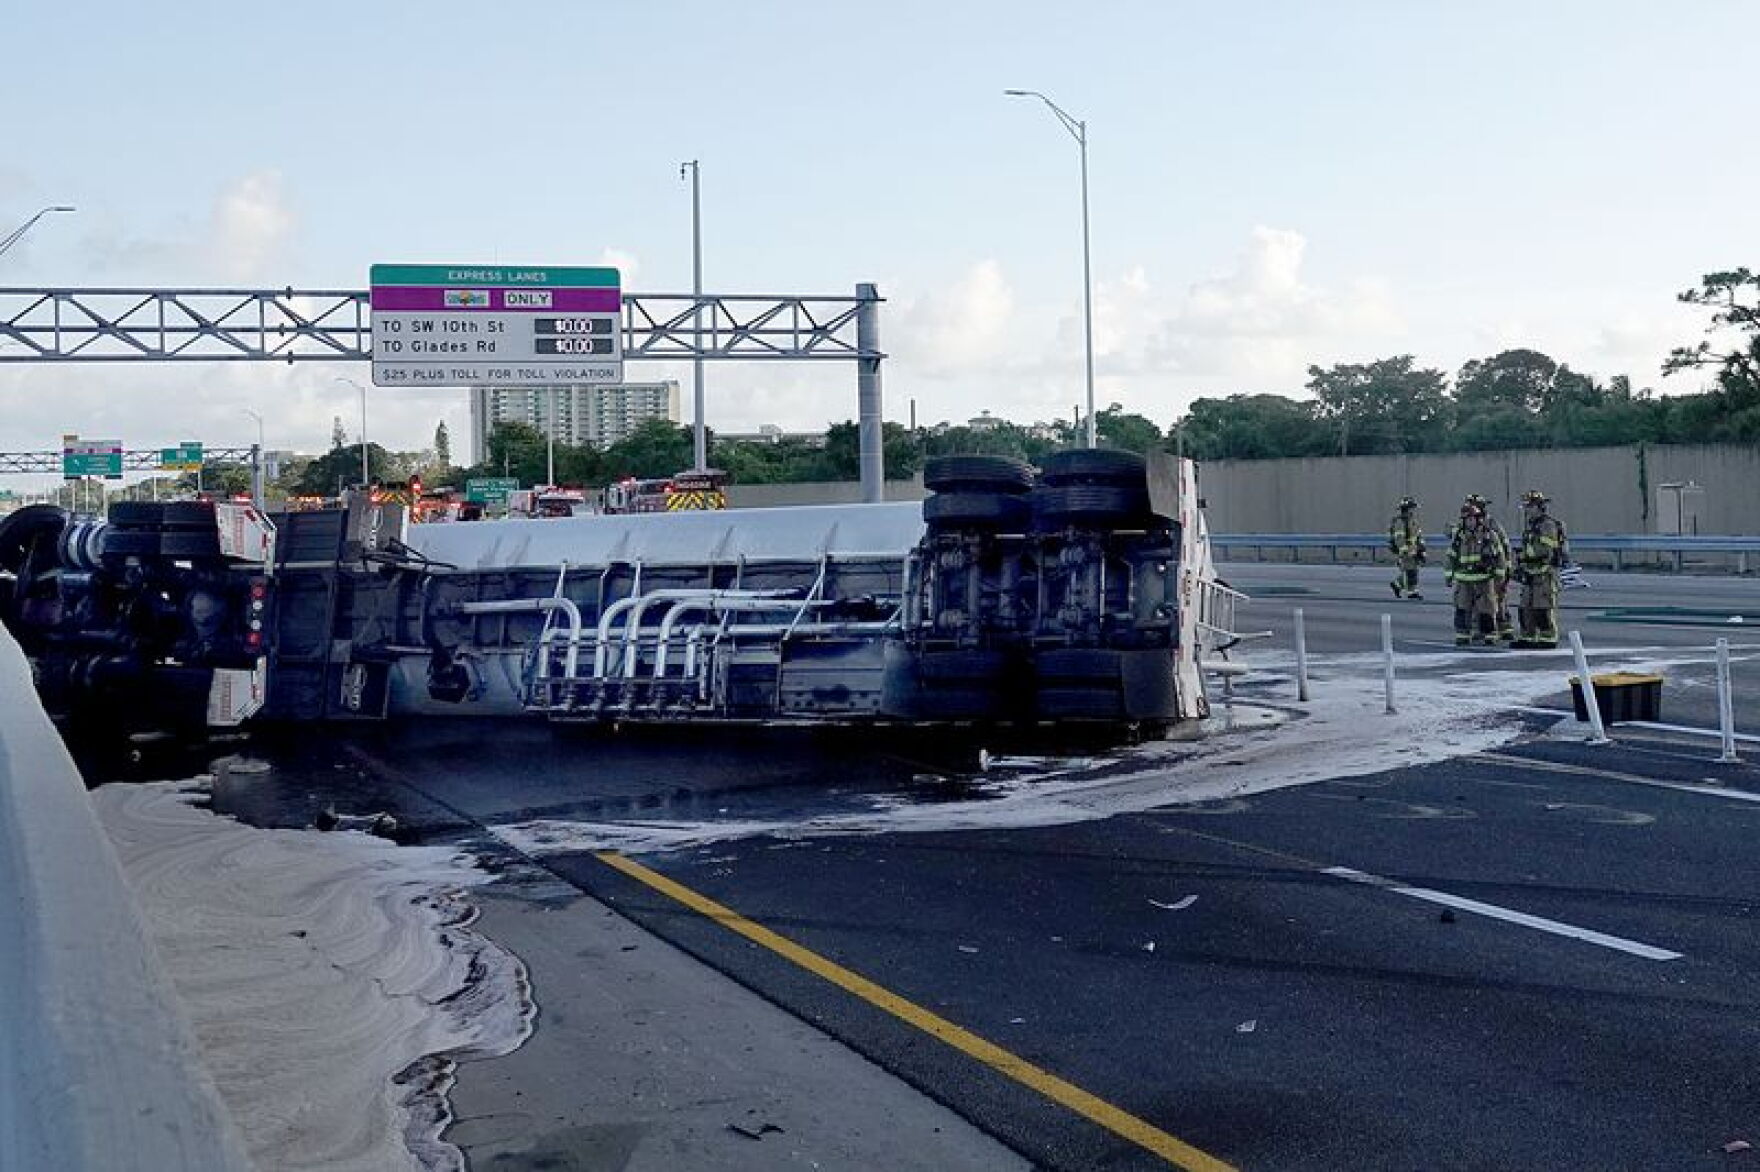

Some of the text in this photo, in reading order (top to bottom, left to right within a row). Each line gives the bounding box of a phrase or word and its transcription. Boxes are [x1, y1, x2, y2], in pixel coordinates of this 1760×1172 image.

[448, 270, 547, 282] EXPRESS LANES
[507, 293, 549, 304] ONLY
[382, 320, 505, 333] TO SW 10th St
[382, 340, 496, 353] TO Glades Rd
[382, 368, 615, 381] $25 PLUS TOLL FOR TOLL VIOLATION
